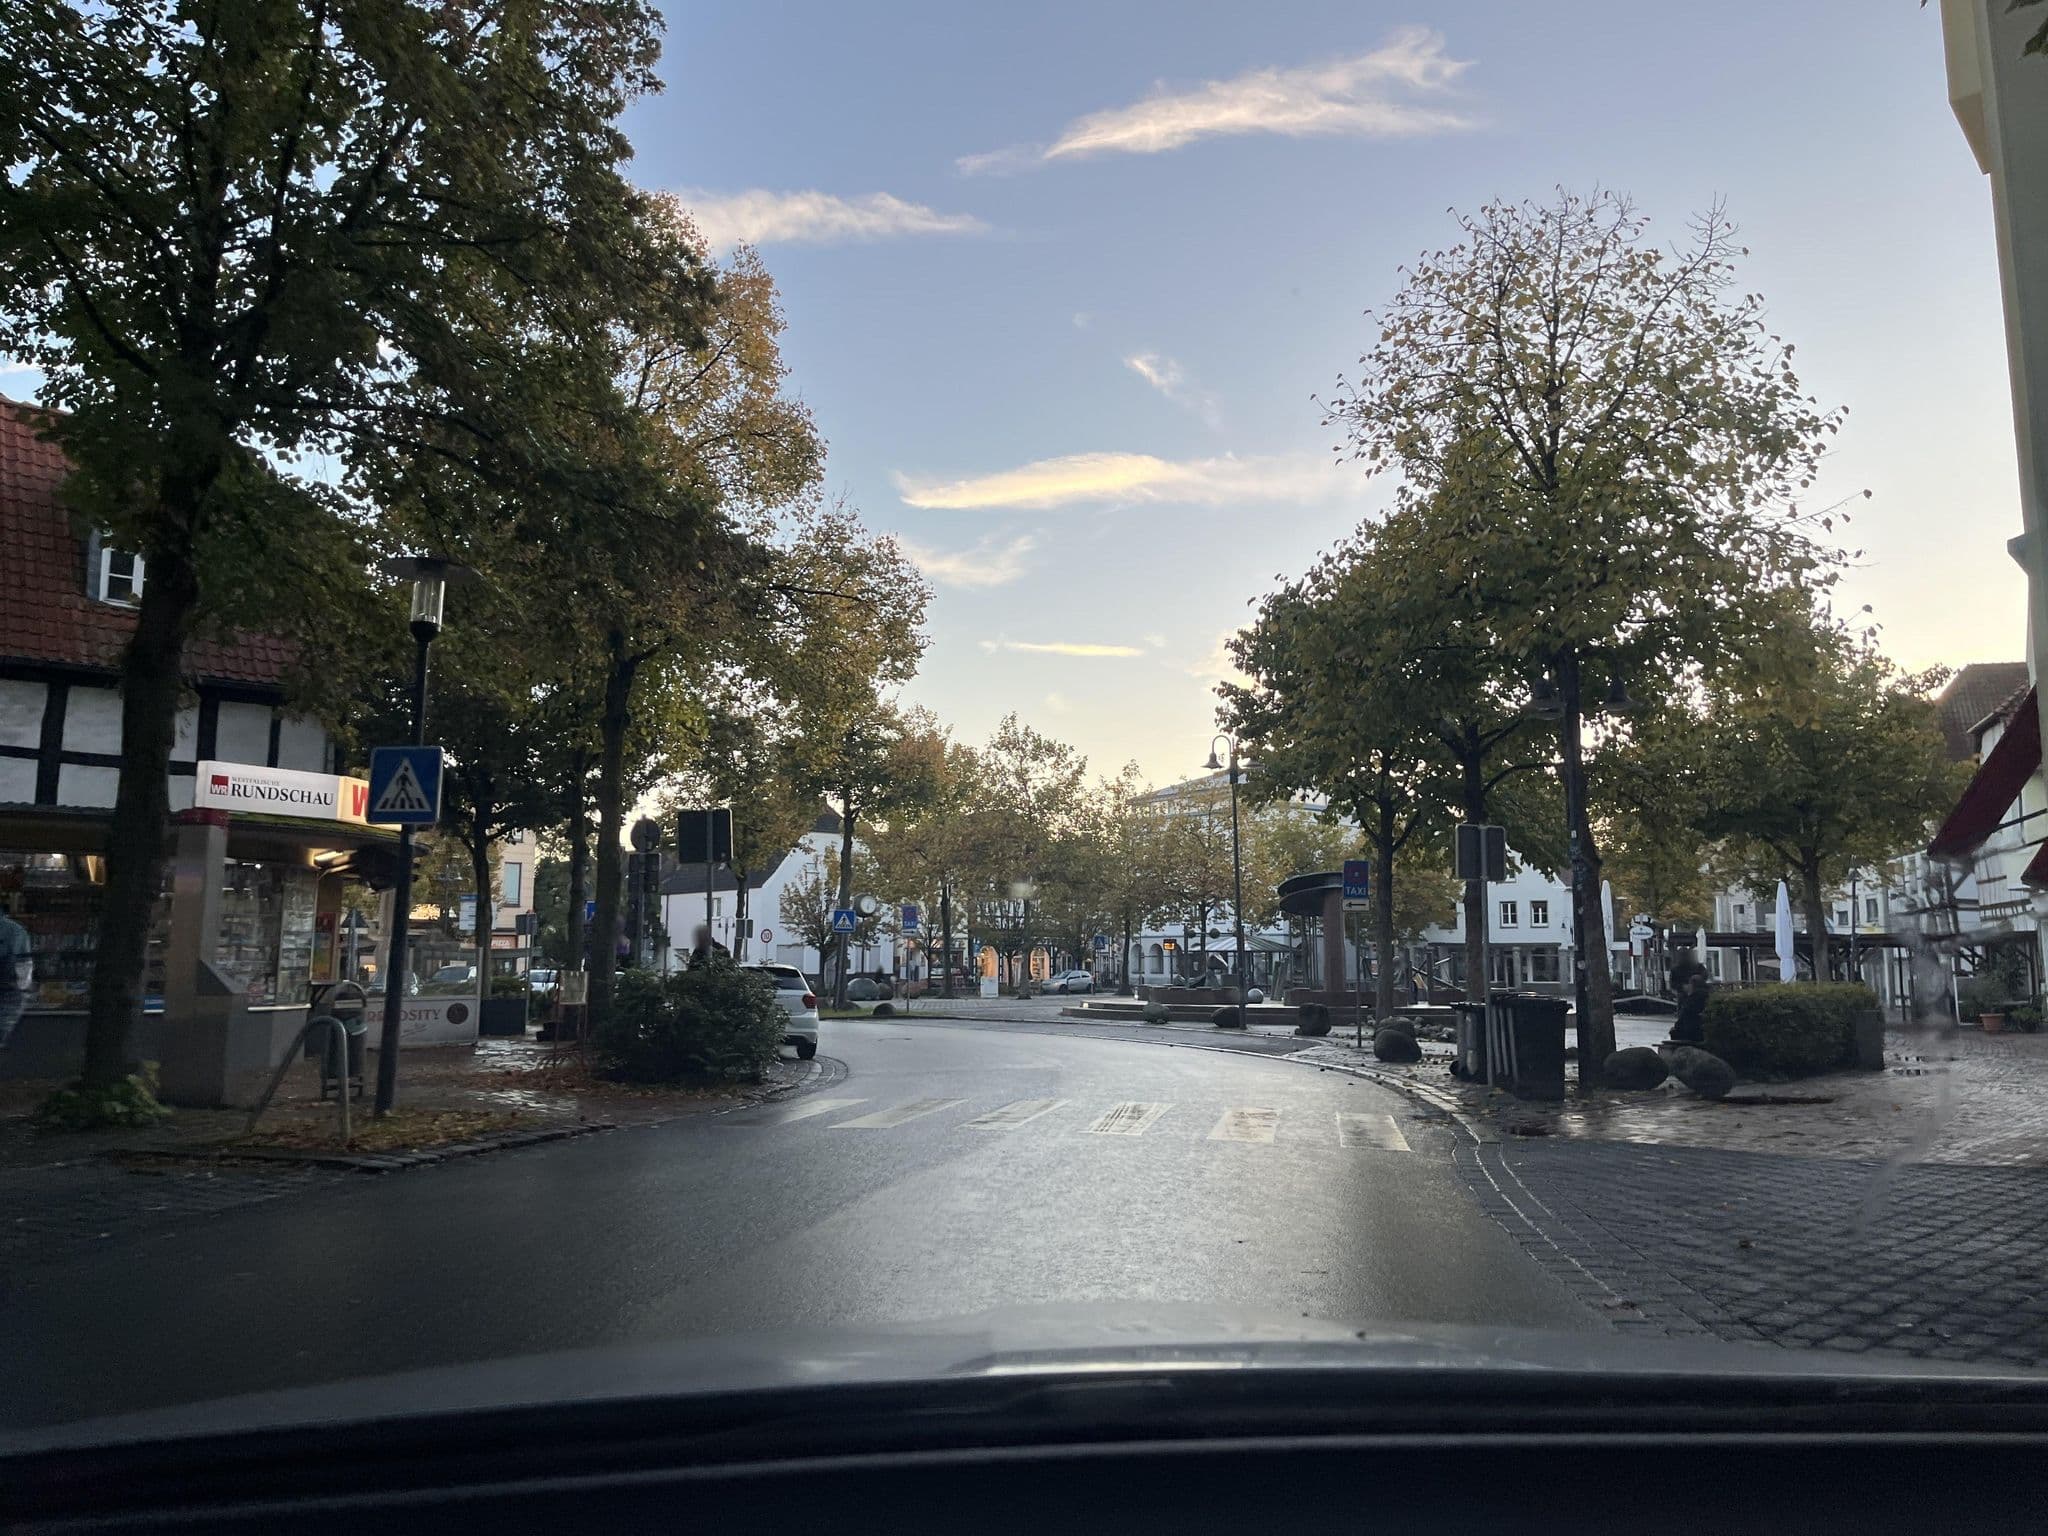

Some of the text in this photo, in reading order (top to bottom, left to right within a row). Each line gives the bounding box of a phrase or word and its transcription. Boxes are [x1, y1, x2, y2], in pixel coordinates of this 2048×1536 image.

[210, 784, 228, 795] WR
[231, 783, 334, 806] RUNDSCHAU
[1345, 886, 1367, 896] TAXI
